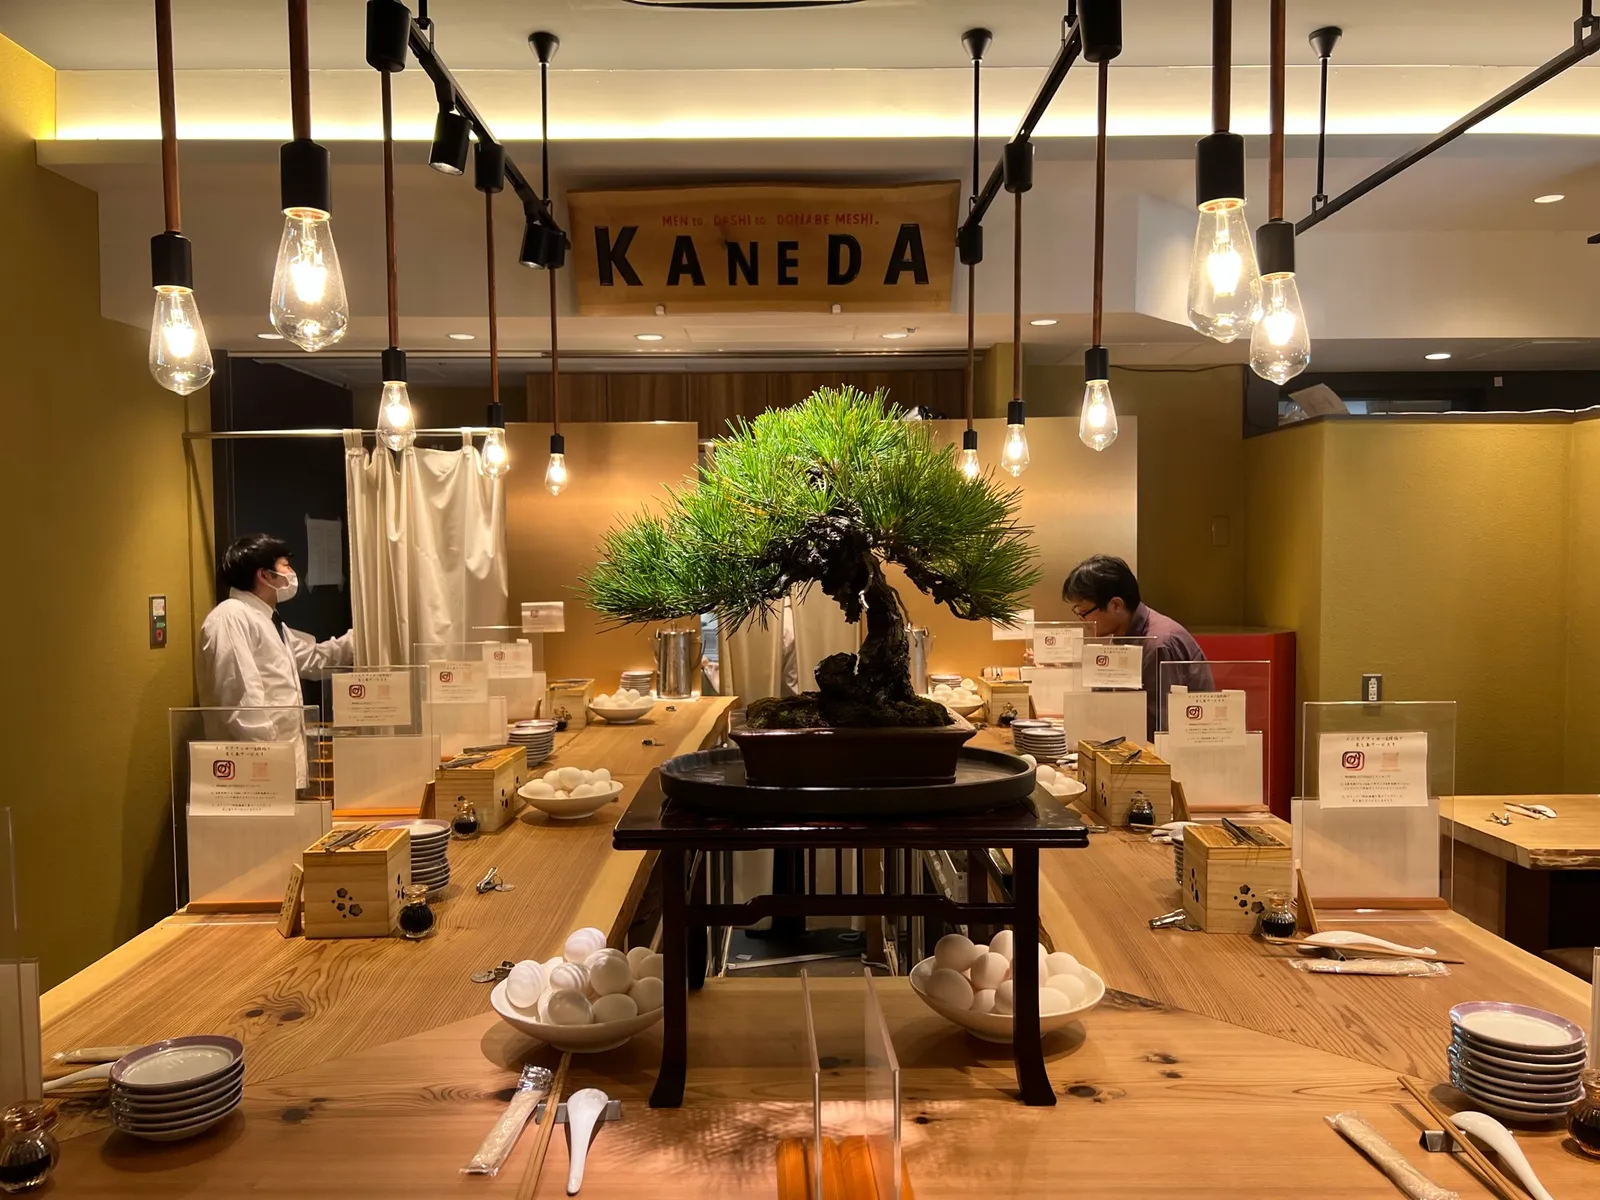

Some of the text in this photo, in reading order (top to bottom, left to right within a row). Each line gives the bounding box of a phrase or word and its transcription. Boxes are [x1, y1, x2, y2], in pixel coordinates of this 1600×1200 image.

[661, 213, 879, 226] MEN to DASHI to DONABE MESHI.
[594, 224, 930, 286] KANEDA
